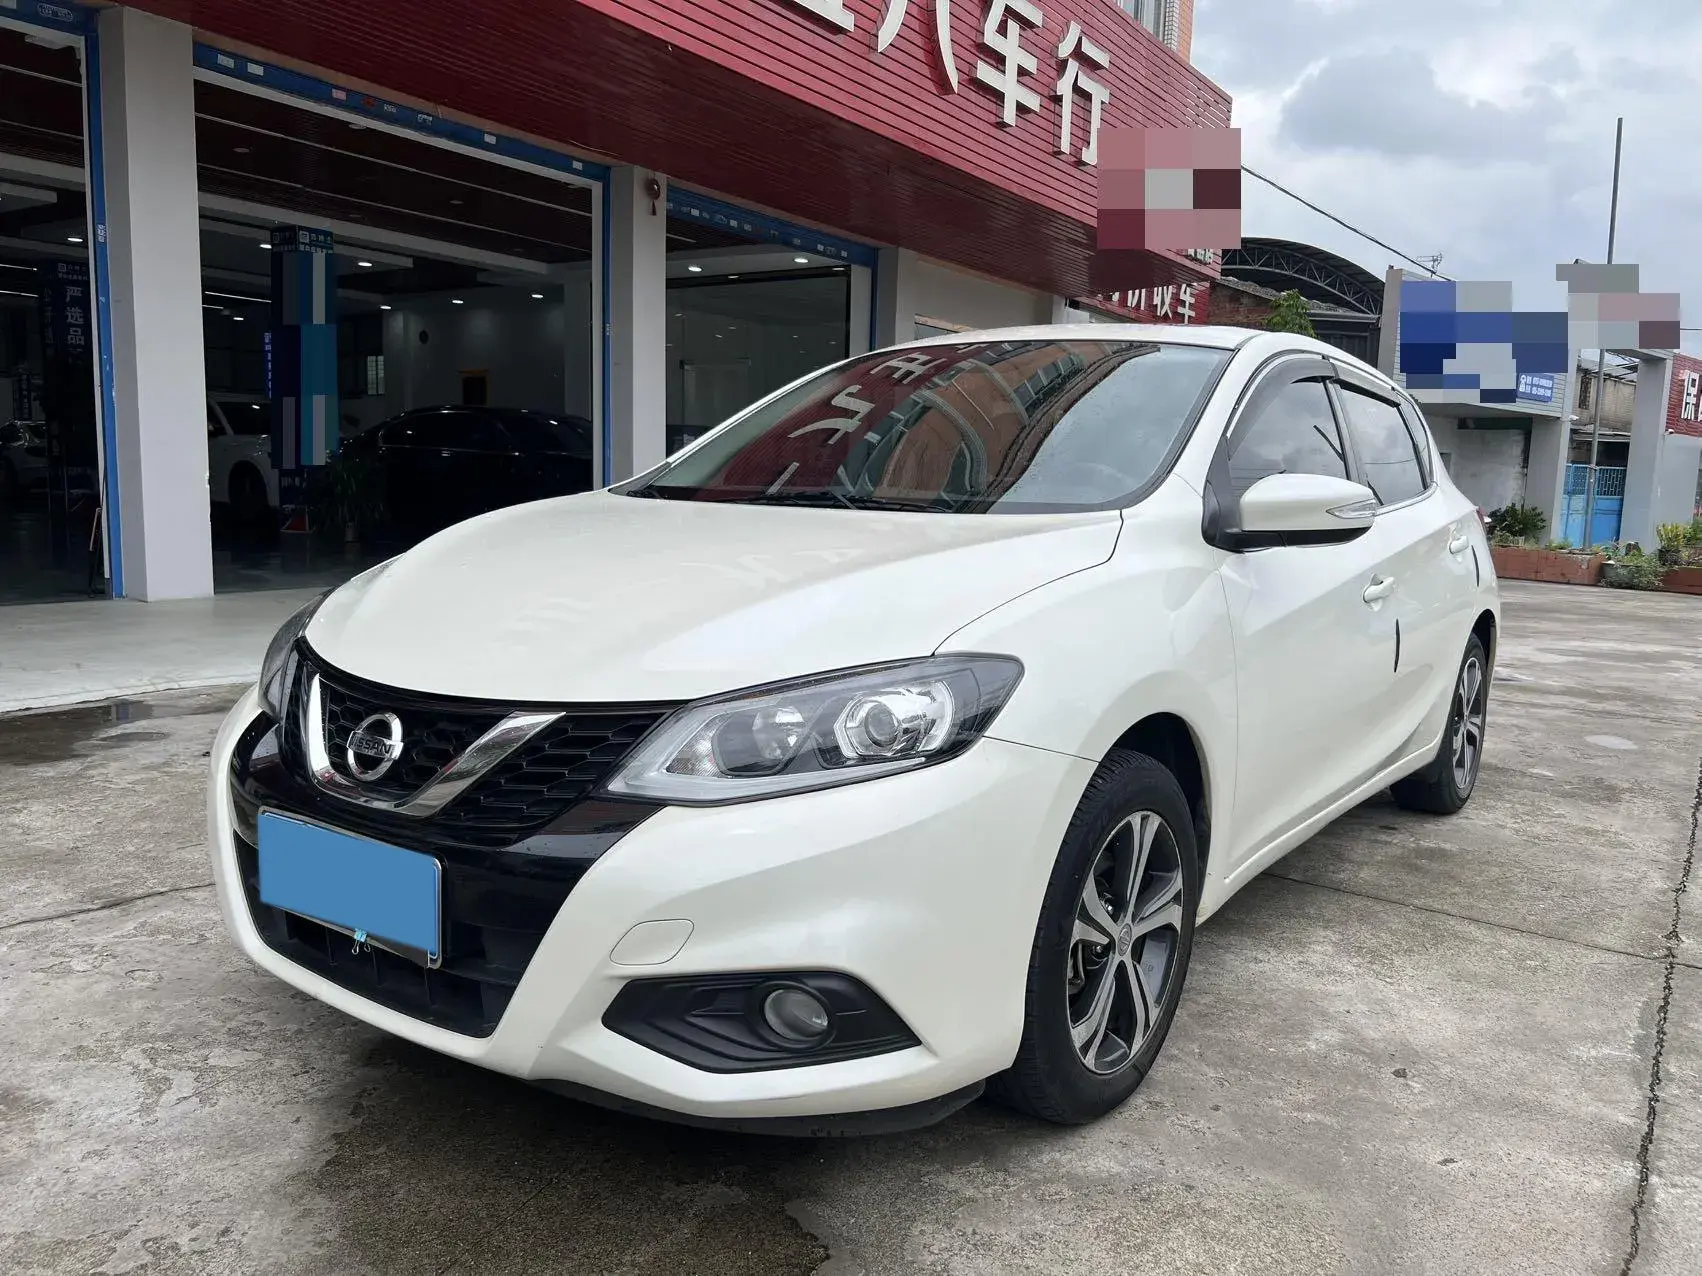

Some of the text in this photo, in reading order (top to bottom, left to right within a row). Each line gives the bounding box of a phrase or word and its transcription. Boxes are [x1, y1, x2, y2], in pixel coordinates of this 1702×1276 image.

[64, 286, 85, 364] 严选品
[1097, 284, 1196, 325] 价收车
[1679, 369, 1702, 421] 保
